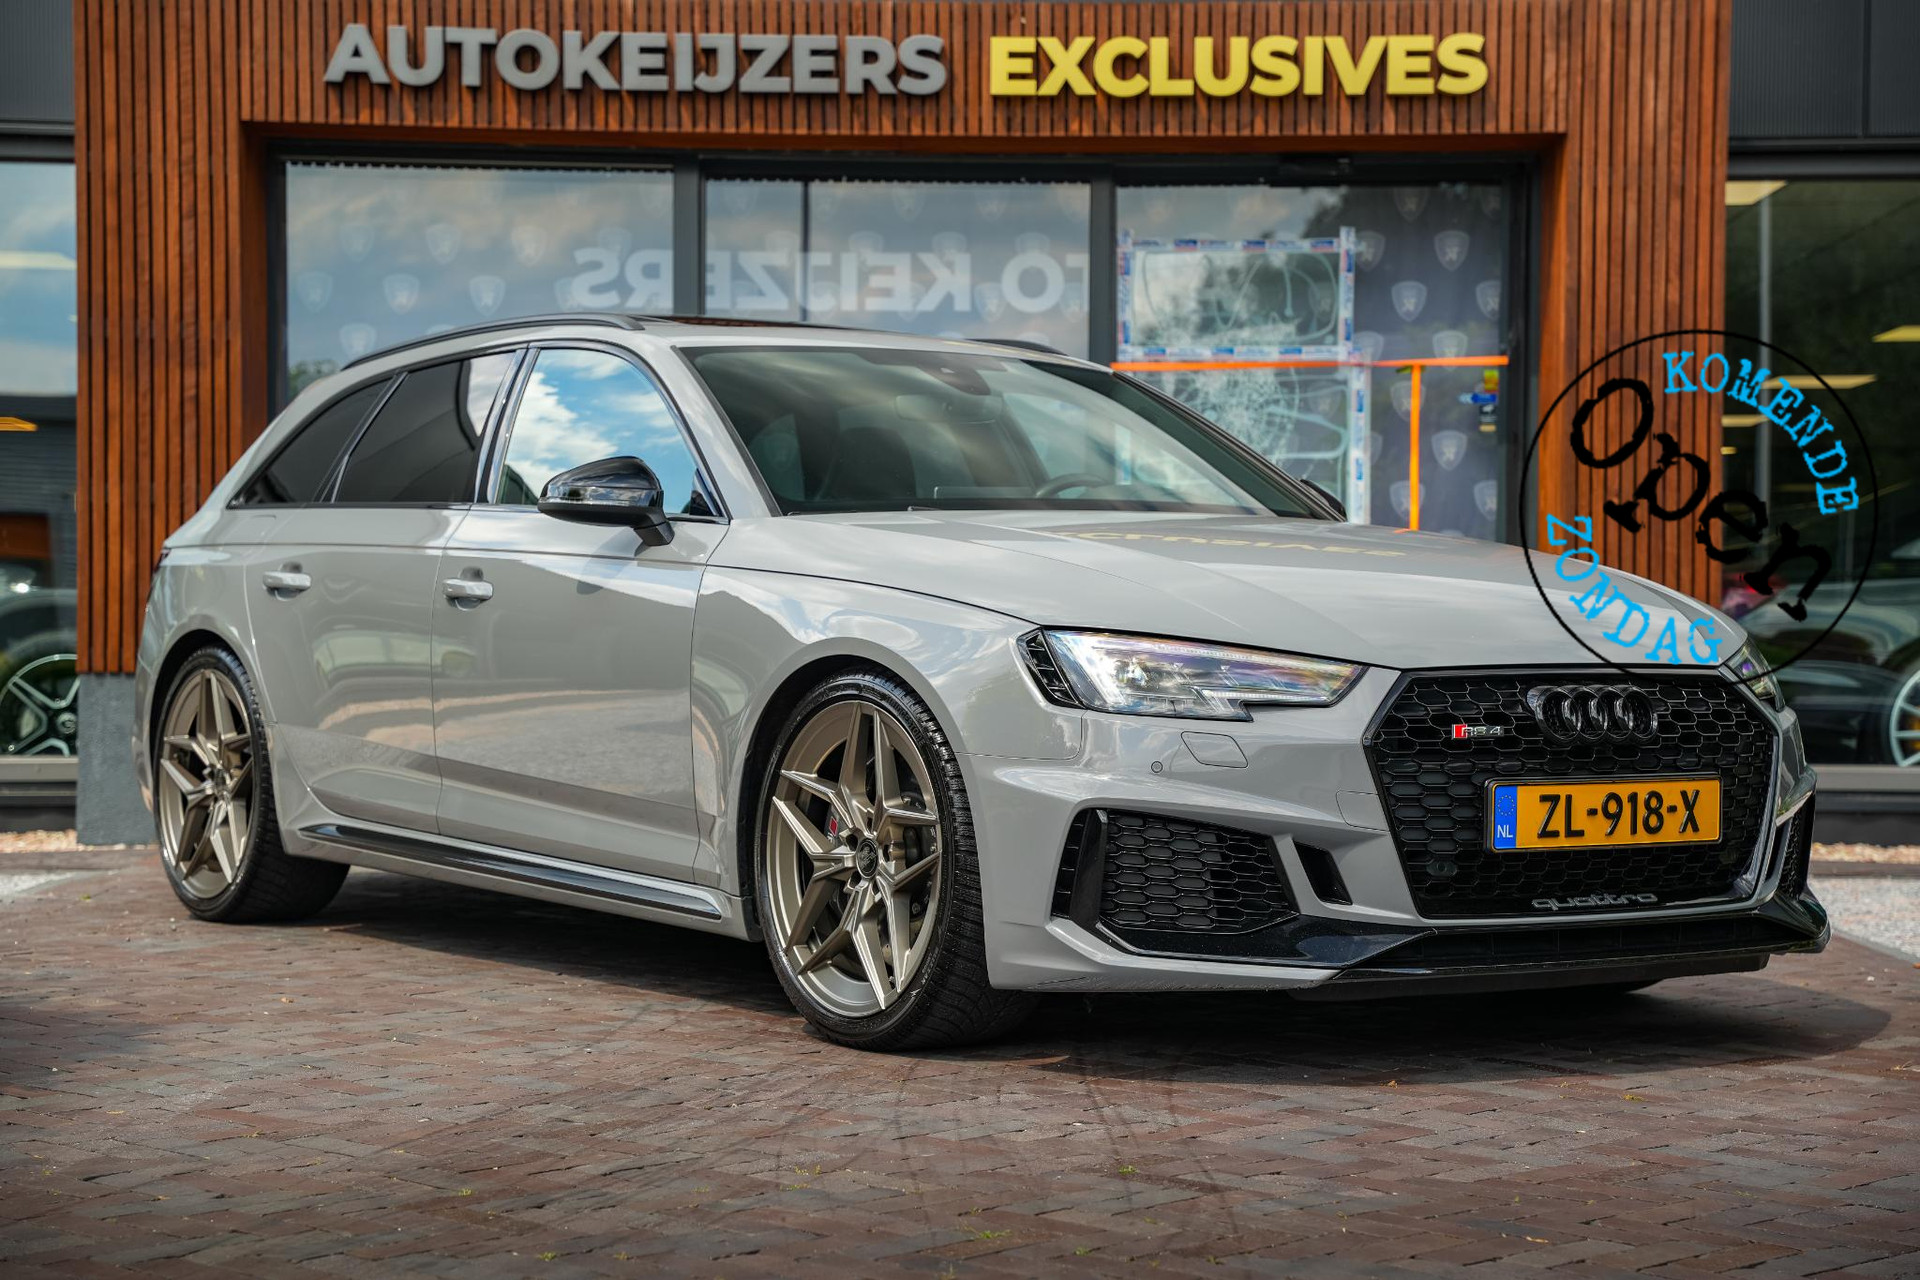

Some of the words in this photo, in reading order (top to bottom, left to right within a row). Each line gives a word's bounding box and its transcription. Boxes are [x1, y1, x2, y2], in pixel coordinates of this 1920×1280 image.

[324, 23, 946, 95] AUTOKEIJZERS
[989, 33, 1488, 97] EXCLUSIVES
[1497, 824, 1514, 838] NL
[1537, 789, 1700, 839] ZL-918-X
[1532, 893, 1658, 911] quattro
